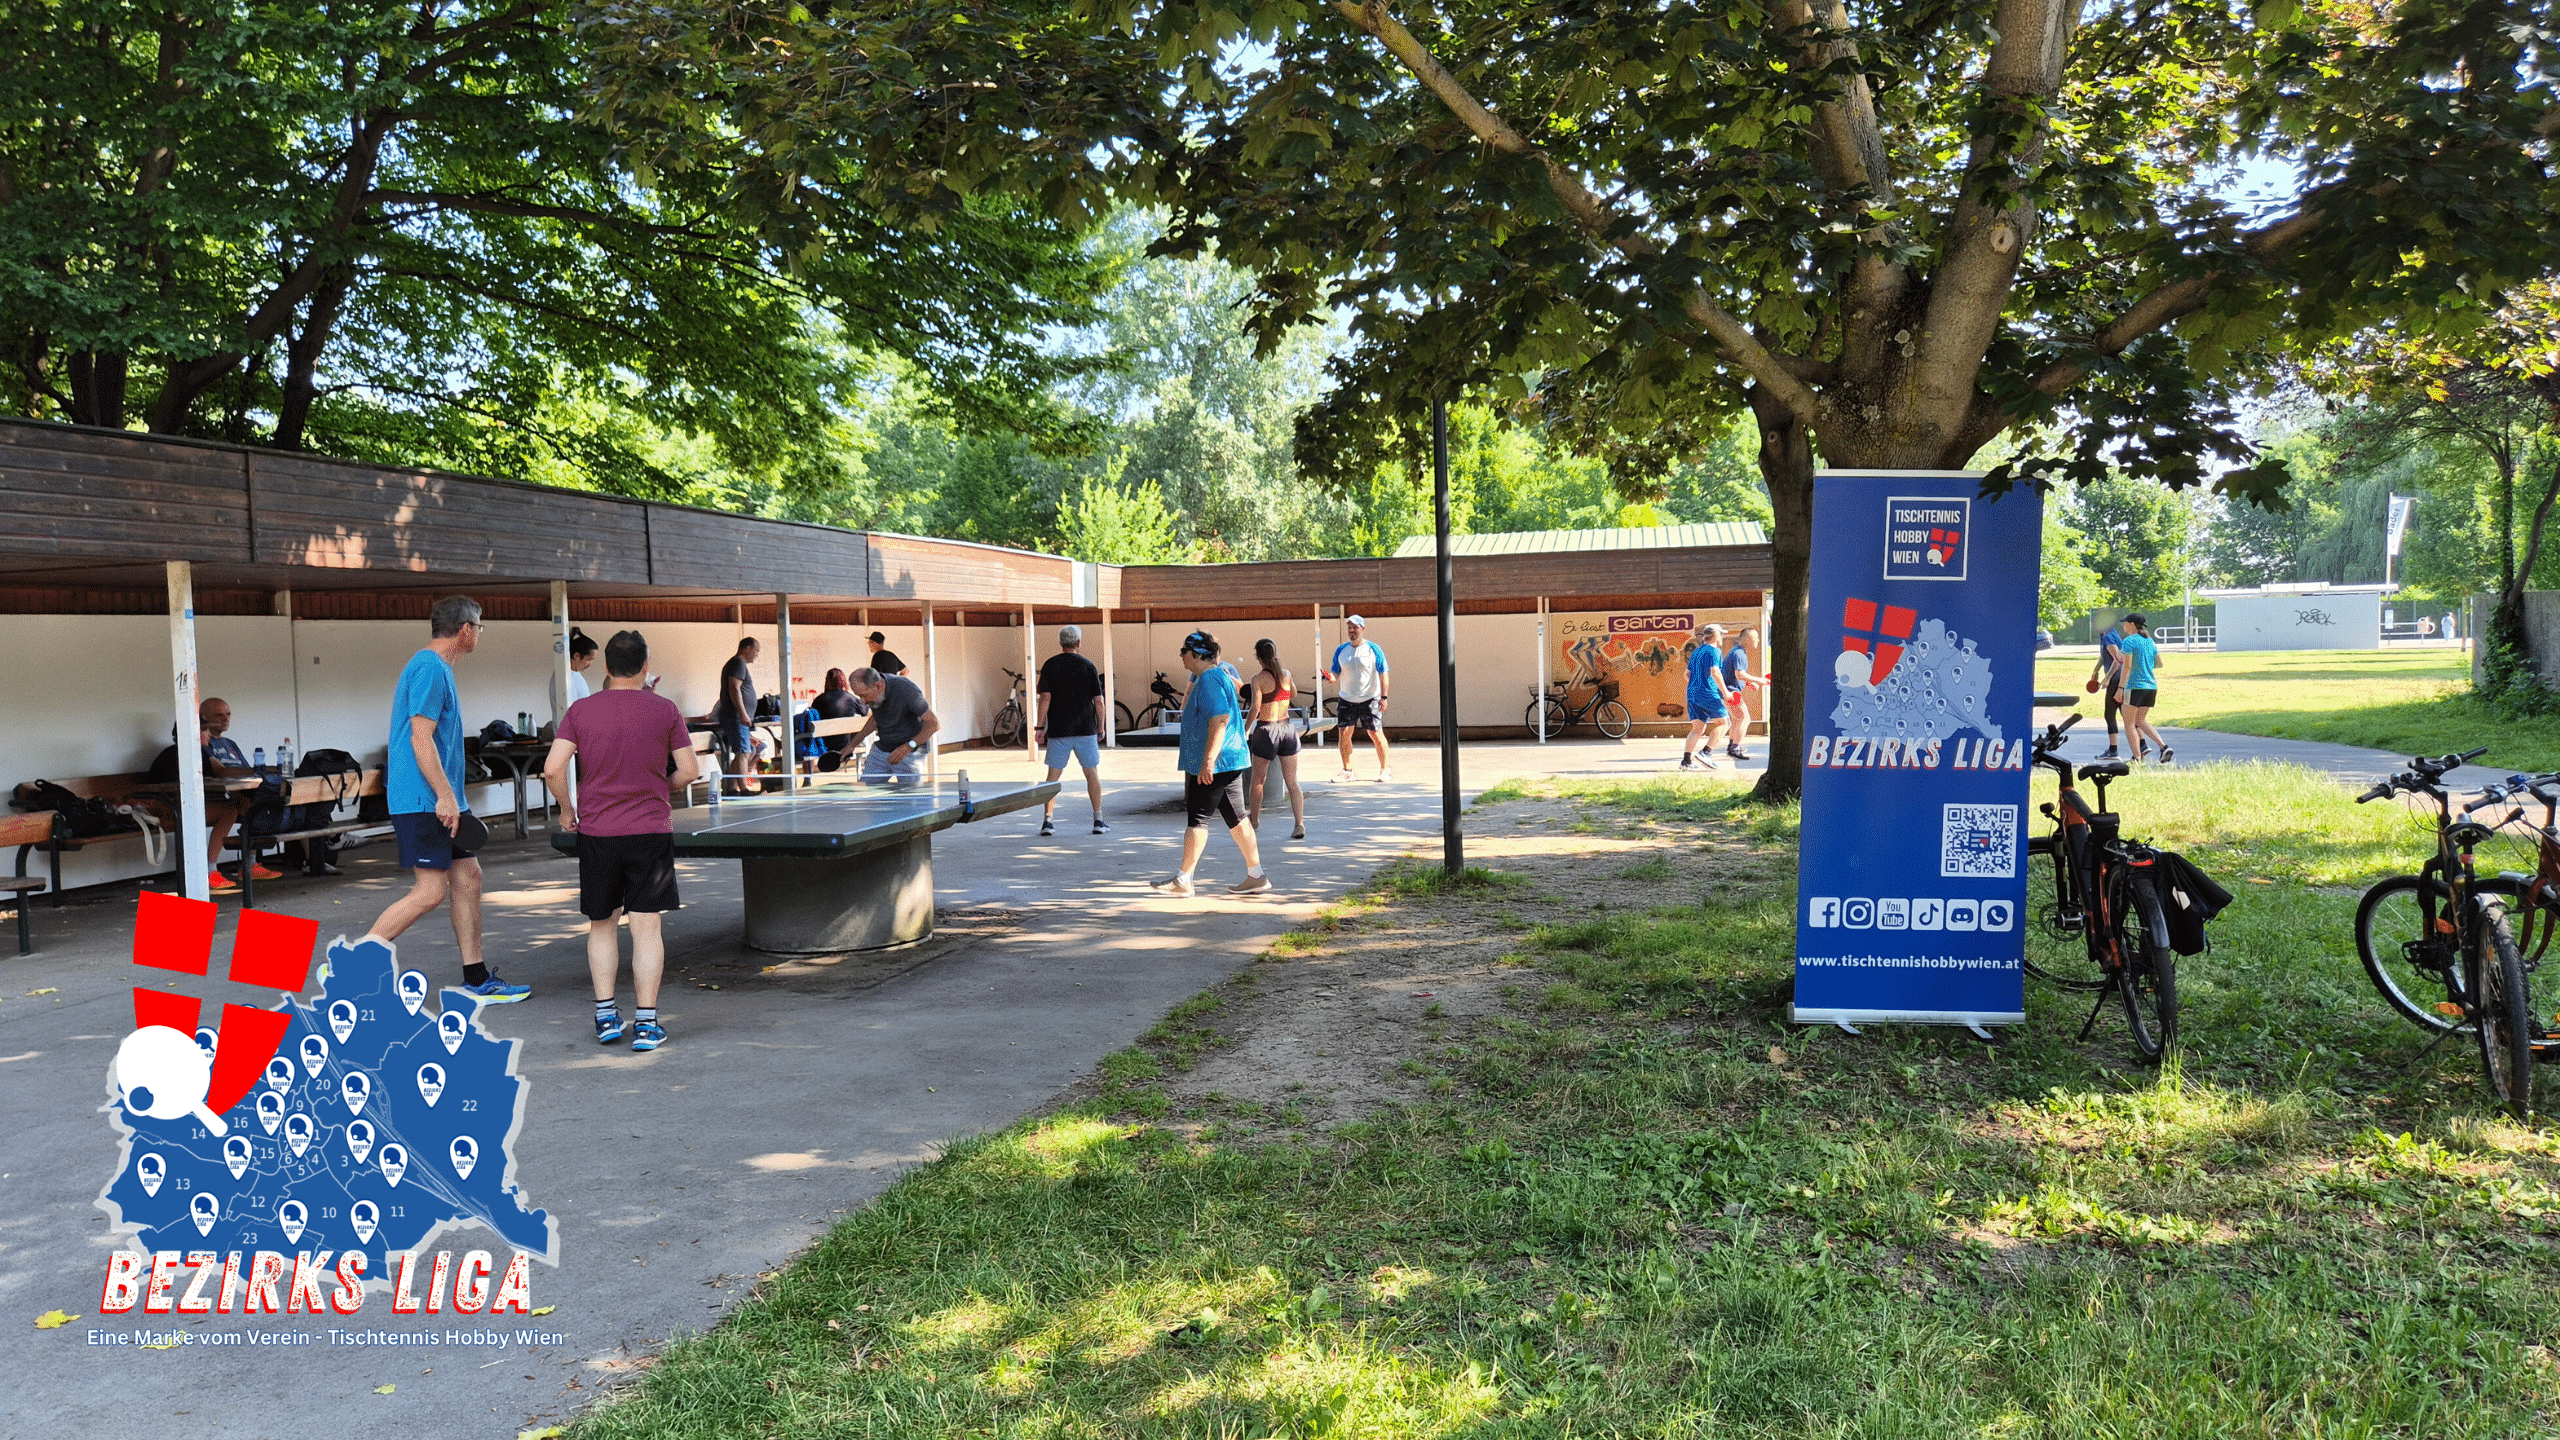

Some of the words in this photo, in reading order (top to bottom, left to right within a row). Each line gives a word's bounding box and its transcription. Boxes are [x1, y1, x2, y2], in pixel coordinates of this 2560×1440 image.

[1894, 509, 1961, 523] TISCHTENNIS
[1893, 530, 1930, 544] HOBBY
[1892, 550, 1920, 564] WIEN
[1613, 616, 1689, 631] garten
[1806, 735, 1942, 770] BEZIRKS
[1952, 738, 2024, 771] LIGA
[1886, 901, 1901, 912] You
[1883, 914, 1904, 926] Tube
[1799, 954, 2020, 970] www.tischtennishobbywien.at
